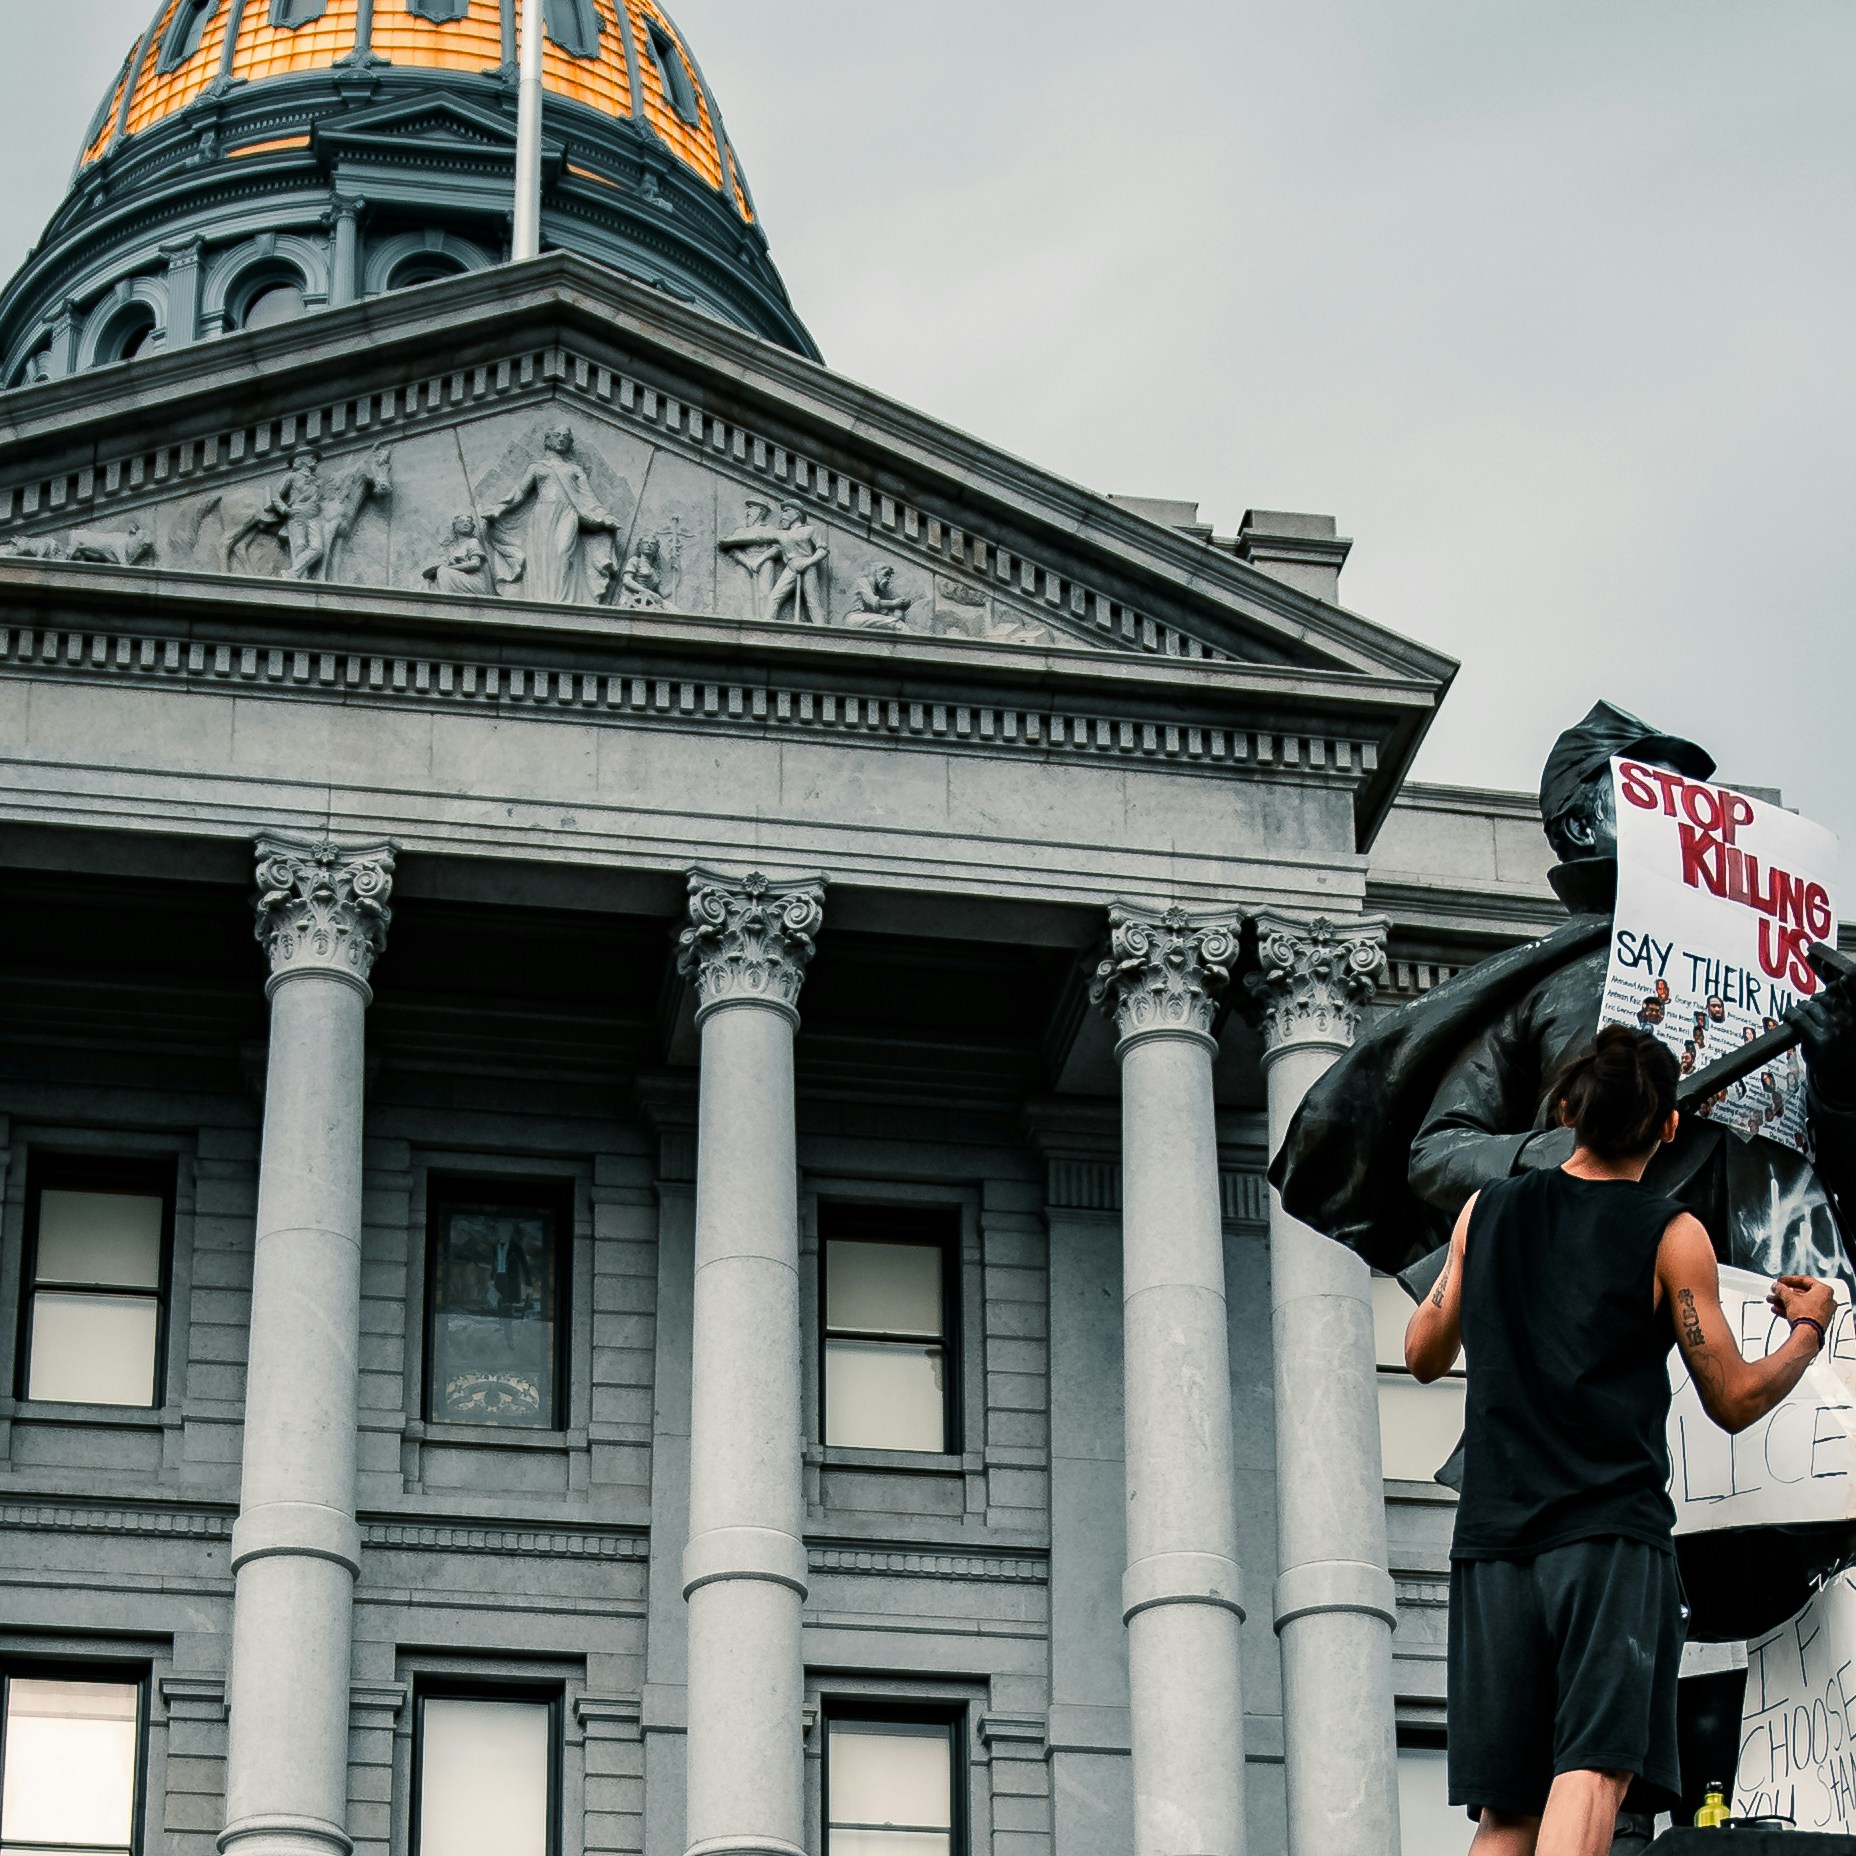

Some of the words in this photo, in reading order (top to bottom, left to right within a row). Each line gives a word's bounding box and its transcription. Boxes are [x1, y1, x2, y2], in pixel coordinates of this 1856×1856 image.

[1619, 762, 1755, 847] STOP
[1616, 929, 1675, 979] SAY
[1683, 950, 1763, 1016] THEIR
[1757, 917, 1821, 997] US
[1743, 1601, 1821, 1721] IF
